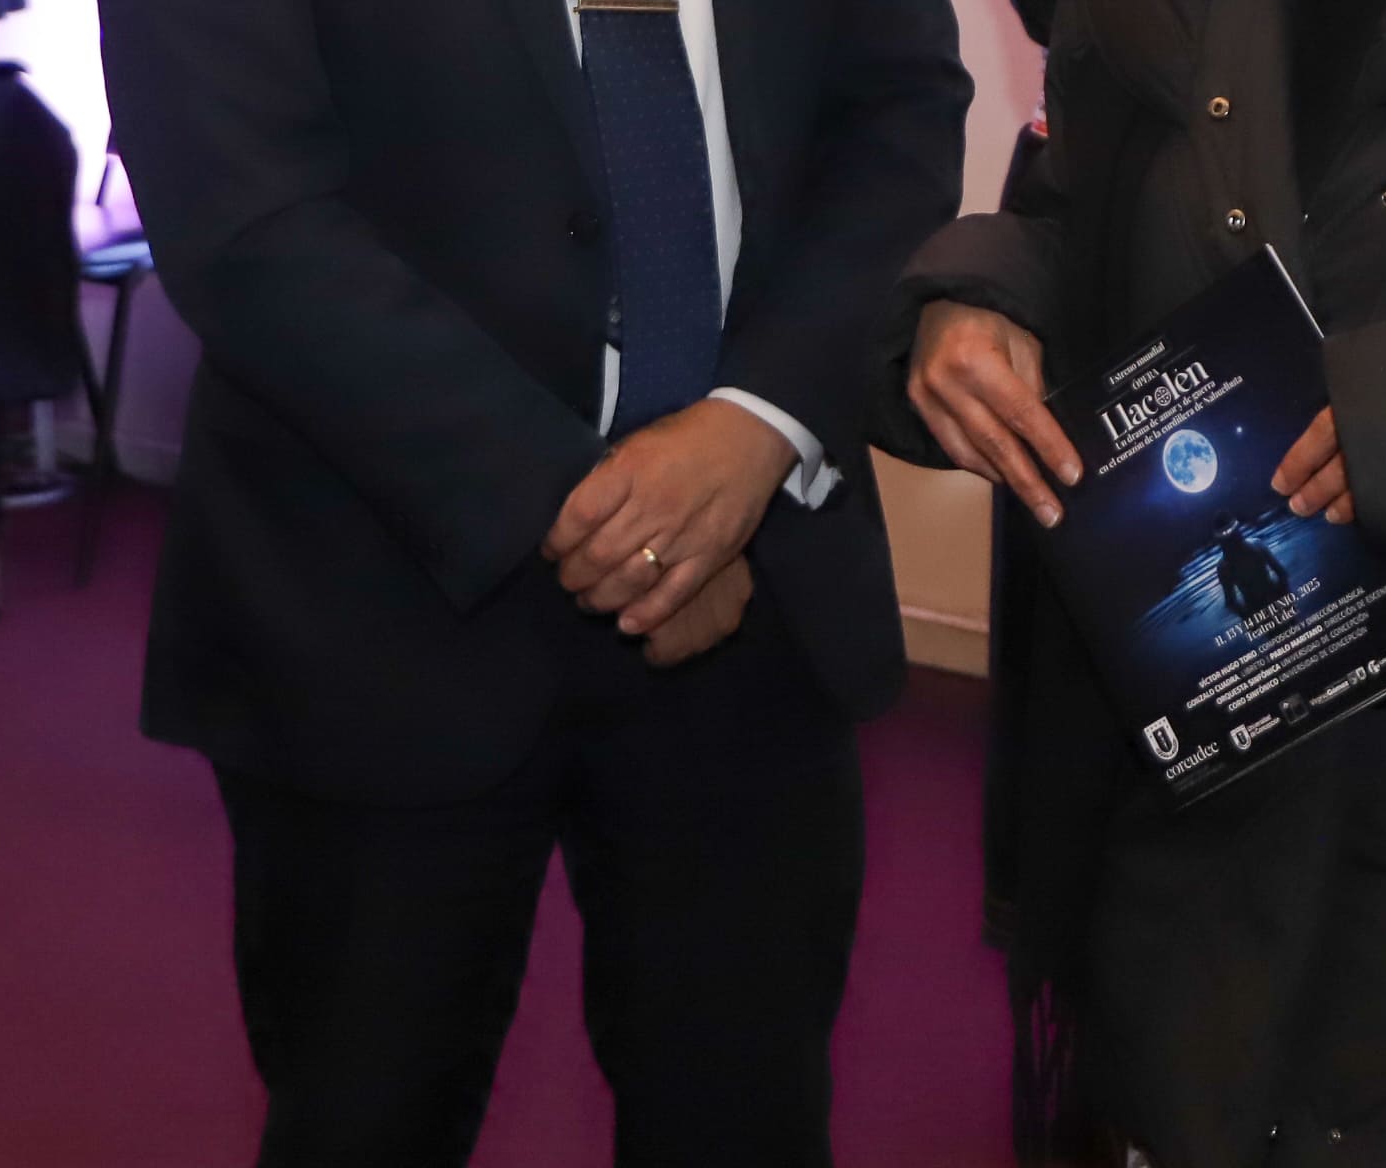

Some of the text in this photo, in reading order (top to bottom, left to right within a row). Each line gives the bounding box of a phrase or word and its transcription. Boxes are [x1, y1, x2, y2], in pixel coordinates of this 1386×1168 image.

[1109, 342, 1165, 385] Estreno mundial
[1132, 369, 1159, 390] ÓPERA
[1116, 441, 1145, 463] corazón
[1161, 408, 1195, 434] cordillera
[1127, 425, 1150, 443] drama
[1150, 419, 1159, 428] de
[1159, 406, 1177, 422] amor
[1183, 396, 1191, 406] de
[1192, 381, 1216, 400] guerra
[1243, 618, 1254, 630] 14
[1253, 610, 1266, 623] DE
[1297, 577, 1320, 598] 2025
[1216, 683, 1249, 704] ORQUESTA
[1247, 663, 1281, 687] SINFÓNICA
[1281, 640, 1320, 667] UNIVERSIDAD
[1330, 612, 1369, 638] CONCEPCIÓN
[1245, 621, 1275, 642] Teatro
[1186, 688, 1215, 709] GONZALO
[1269, 644, 1291, 660] PABLO
[1199, 671, 1222, 688] VÍCTOR
[1221, 660, 1240, 675] HUGO
[1228, 697, 1246, 711] CORO
[1246, 678, 1279, 701] SINFÓNICO
[1279, 655, 1318, 682] UNIVERSIDAD
[1328, 627, 1368, 653] CONCEPCIÓN
